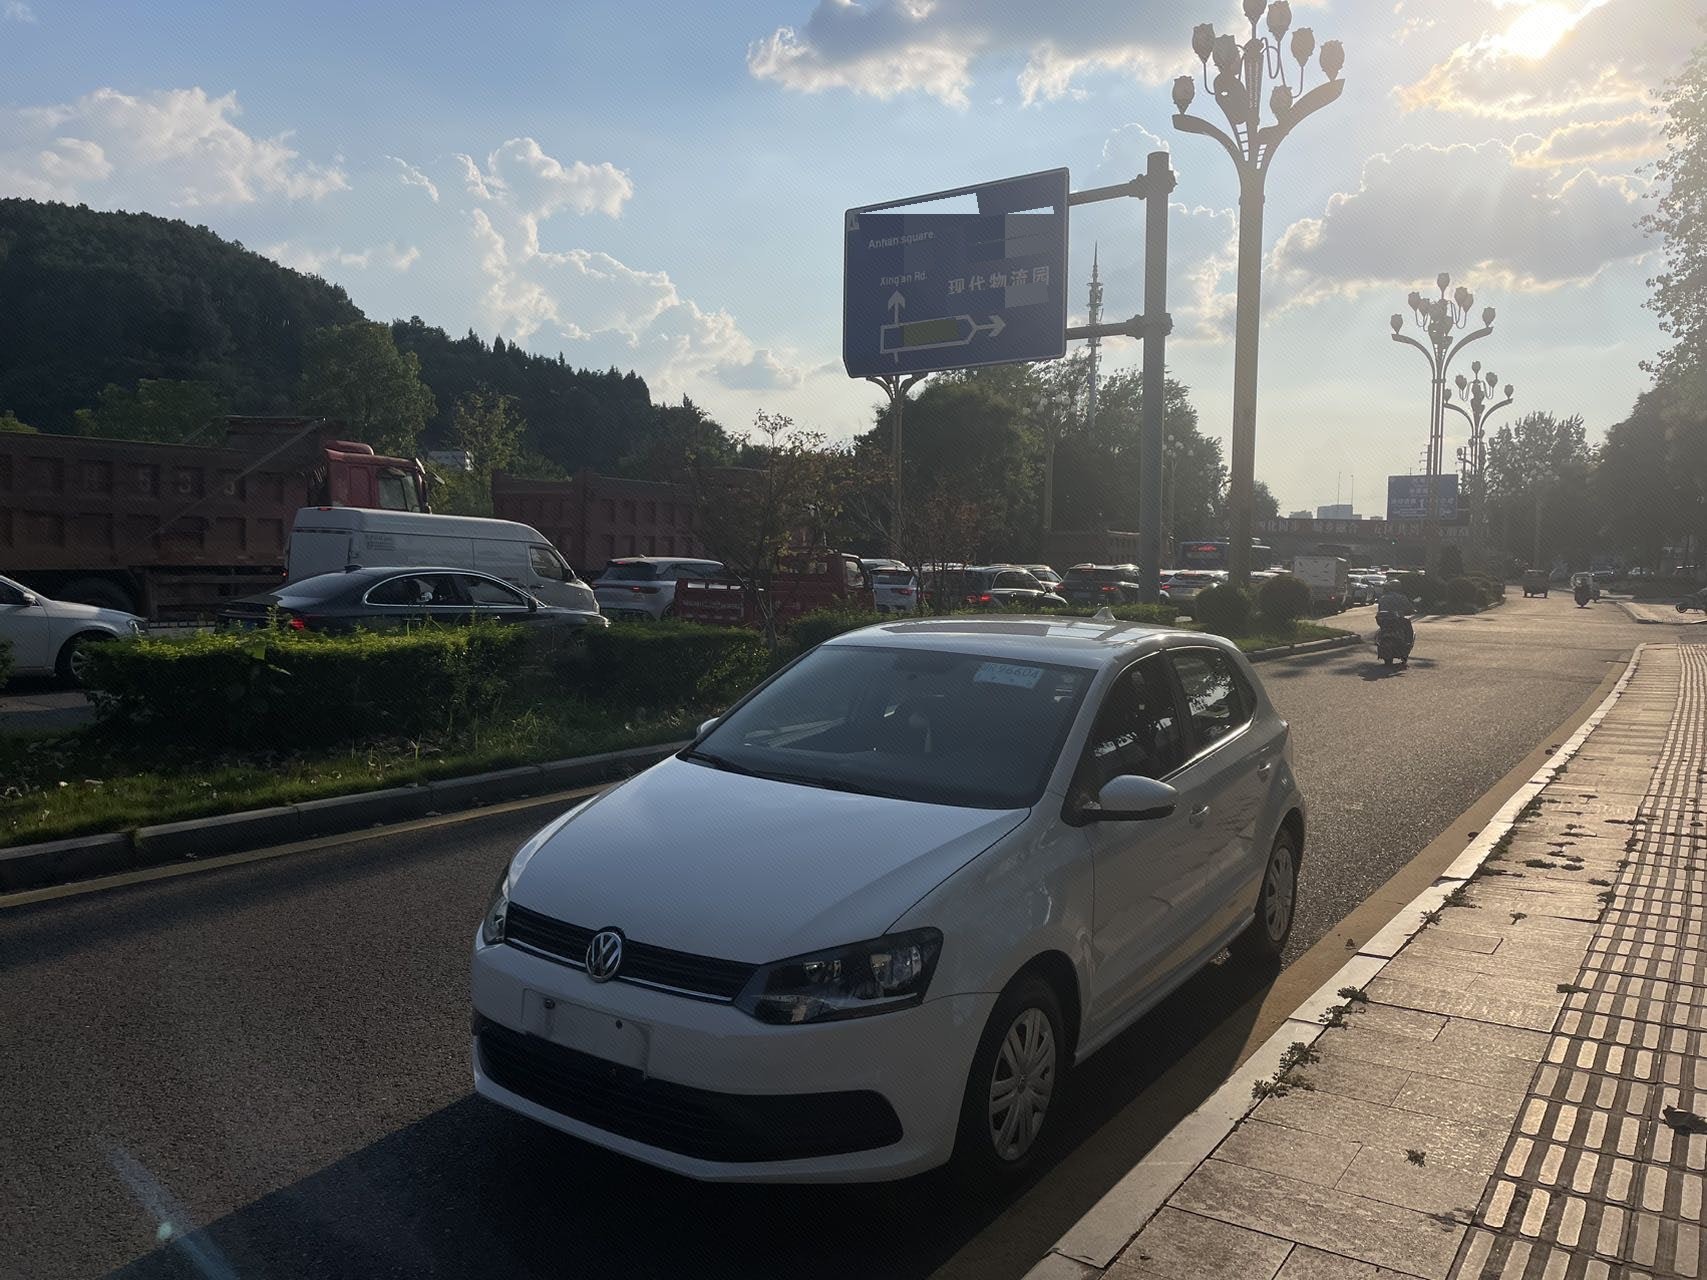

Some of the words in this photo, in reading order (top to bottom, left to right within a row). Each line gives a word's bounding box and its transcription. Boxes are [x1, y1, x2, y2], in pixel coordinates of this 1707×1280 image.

[948, 266, 1049, 295] 现代物流园
